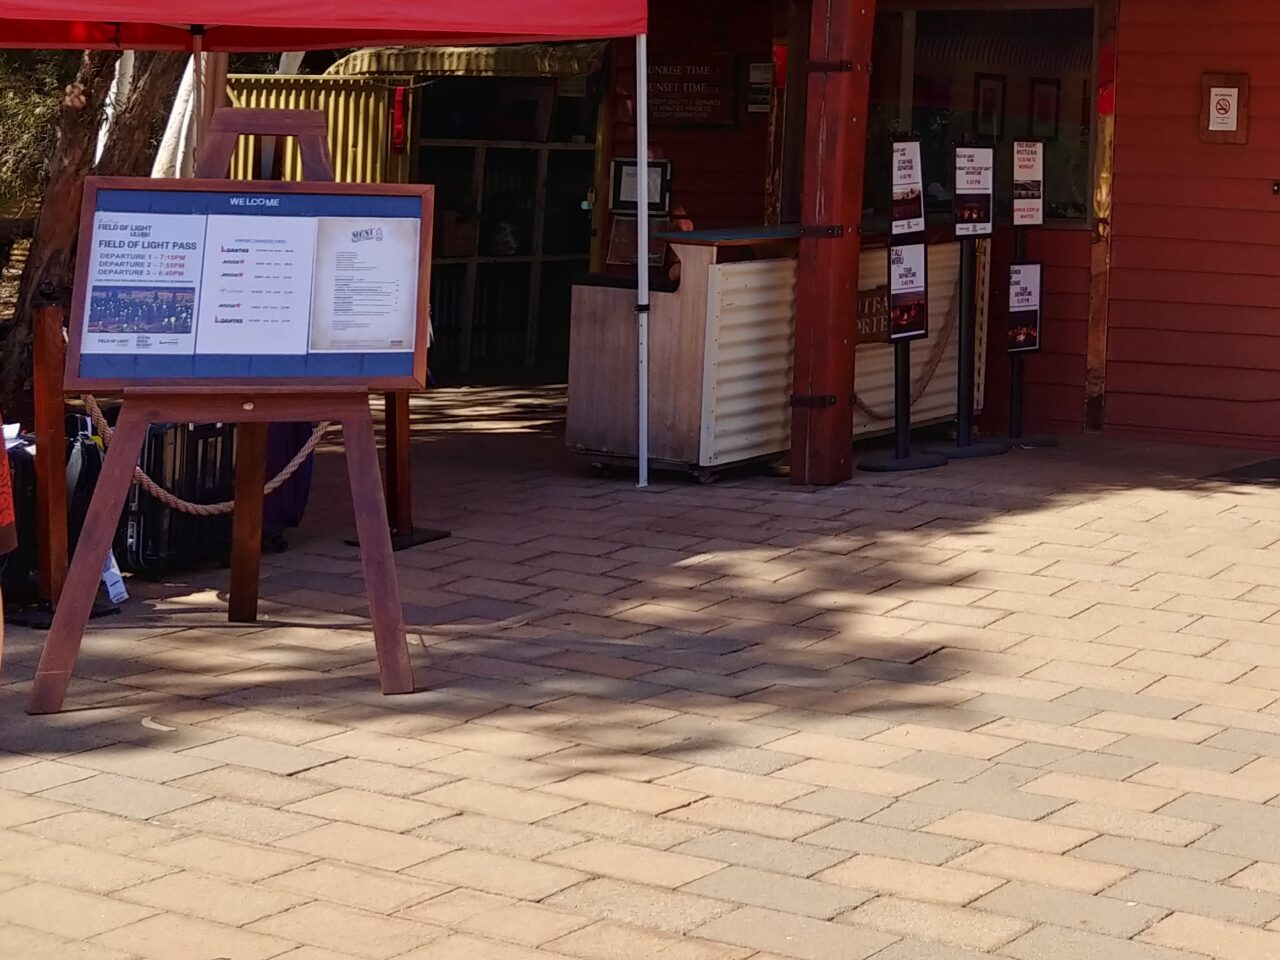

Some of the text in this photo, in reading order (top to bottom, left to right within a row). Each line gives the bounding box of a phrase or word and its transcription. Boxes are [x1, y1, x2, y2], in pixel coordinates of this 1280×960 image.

[648, 65, 711, 75] UNRISE TIME
[647, 82, 679, 92] UNSET
[682, 82, 707, 93] TIME
[229, 197, 280, 207] WELCOME
[98, 223, 119, 231] FIELD
[98, 240, 197, 250] FIELD OF LIGHT PASS
[99, 252, 146, 260] DEPARTURE
[99, 260, 145, 268] DEPARTURE
